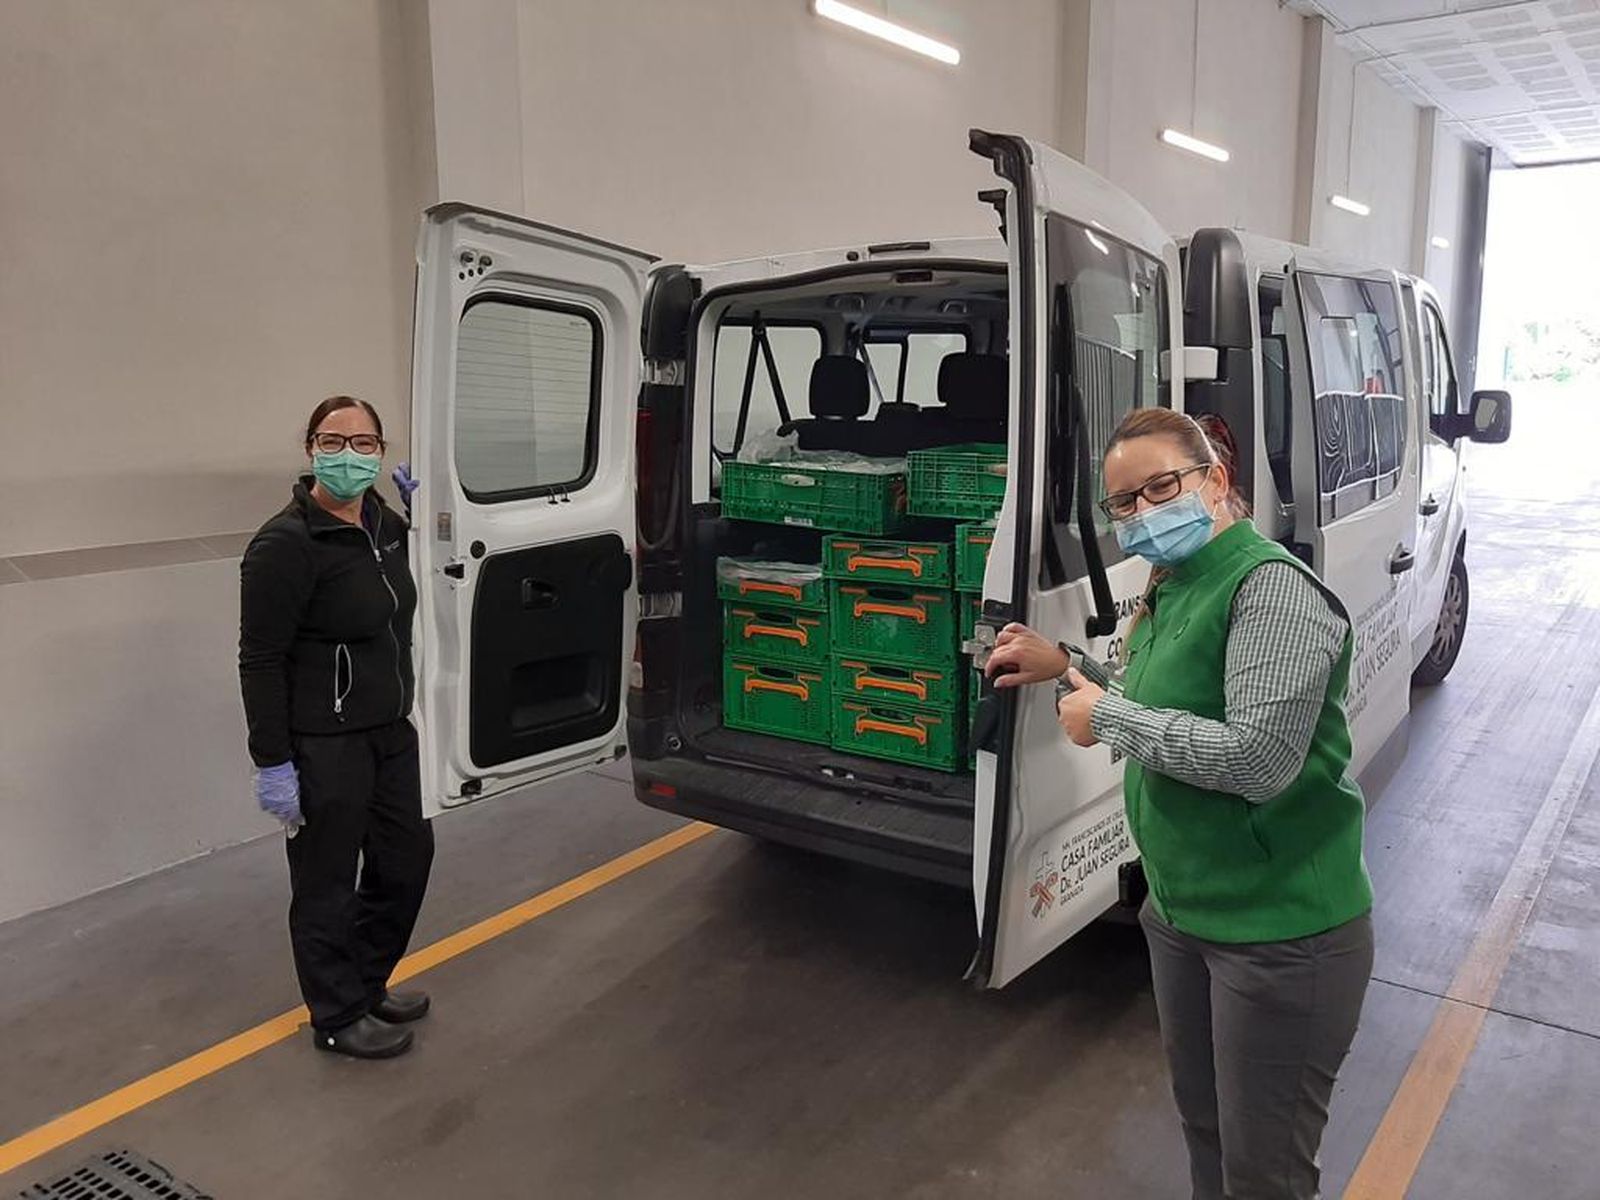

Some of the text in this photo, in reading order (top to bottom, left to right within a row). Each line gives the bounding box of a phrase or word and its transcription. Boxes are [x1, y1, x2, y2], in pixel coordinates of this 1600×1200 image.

[1061, 820, 1124, 872] CASA FAMILIAR
[1074, 855, 1099, 885] JUAN
[1100, 835, 1129, 868] SEGURA
